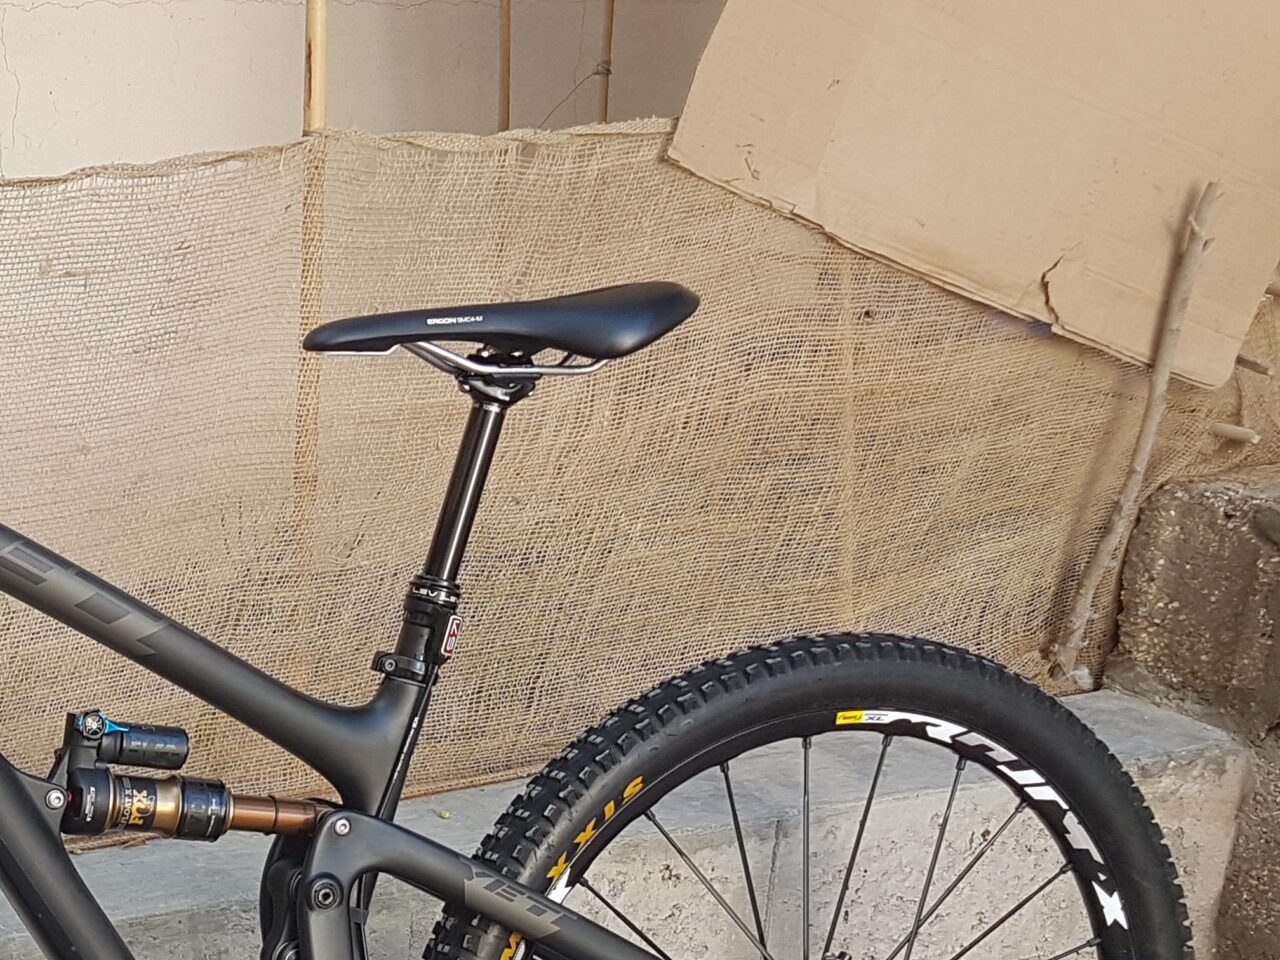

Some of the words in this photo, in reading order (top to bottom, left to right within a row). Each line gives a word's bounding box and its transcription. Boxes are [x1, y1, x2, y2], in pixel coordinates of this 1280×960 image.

[426, 317, 457, 325] ERGON
[412, 587, 439, 597] LEV
[440, 590, 459, 603] LE
[129, 789, 154, 825] FOX
[464, 860, 578, 938] YETI
